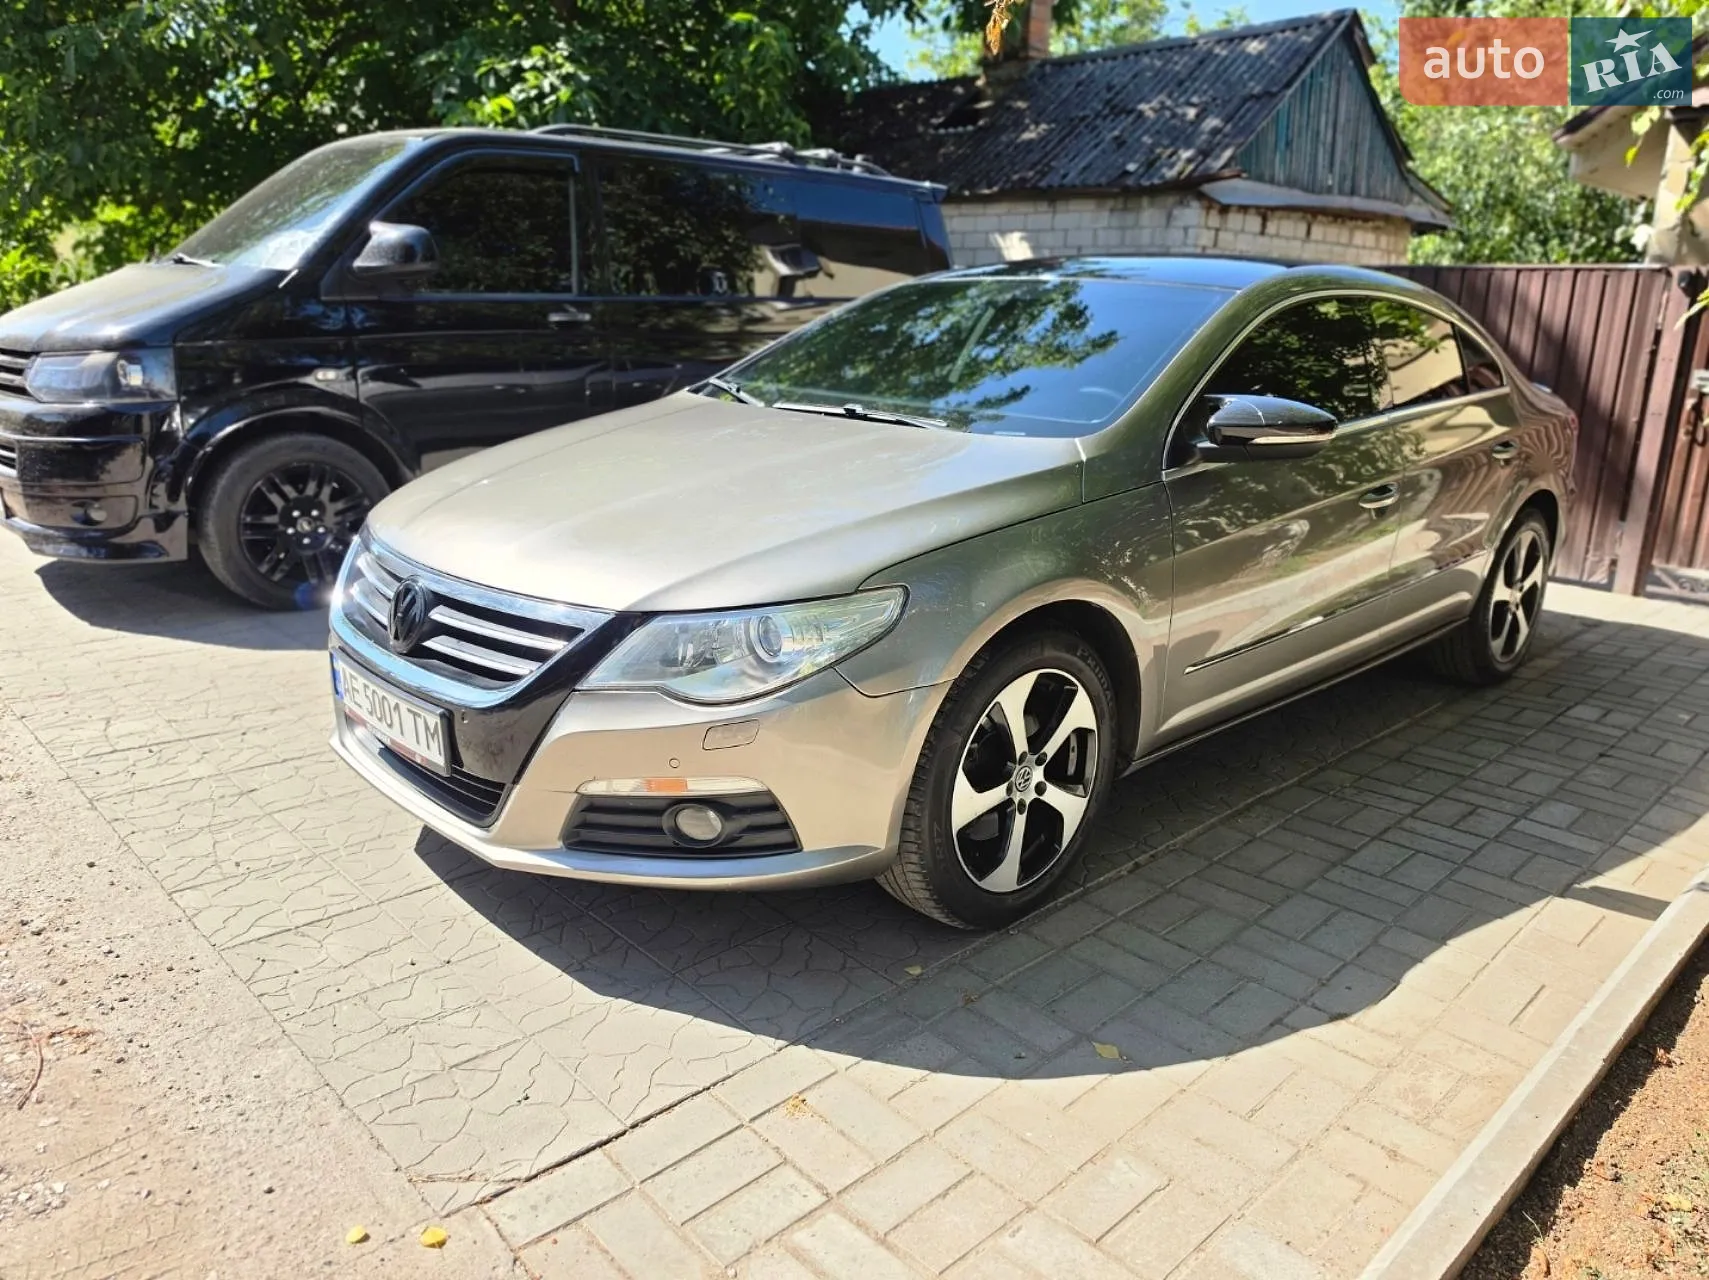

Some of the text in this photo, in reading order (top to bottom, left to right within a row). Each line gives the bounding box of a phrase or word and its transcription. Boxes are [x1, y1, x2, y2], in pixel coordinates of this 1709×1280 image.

[343, 667, 362, 709] AE
[363, 682, 405, 737] 5001
[407, 707, 442, 757] TM
